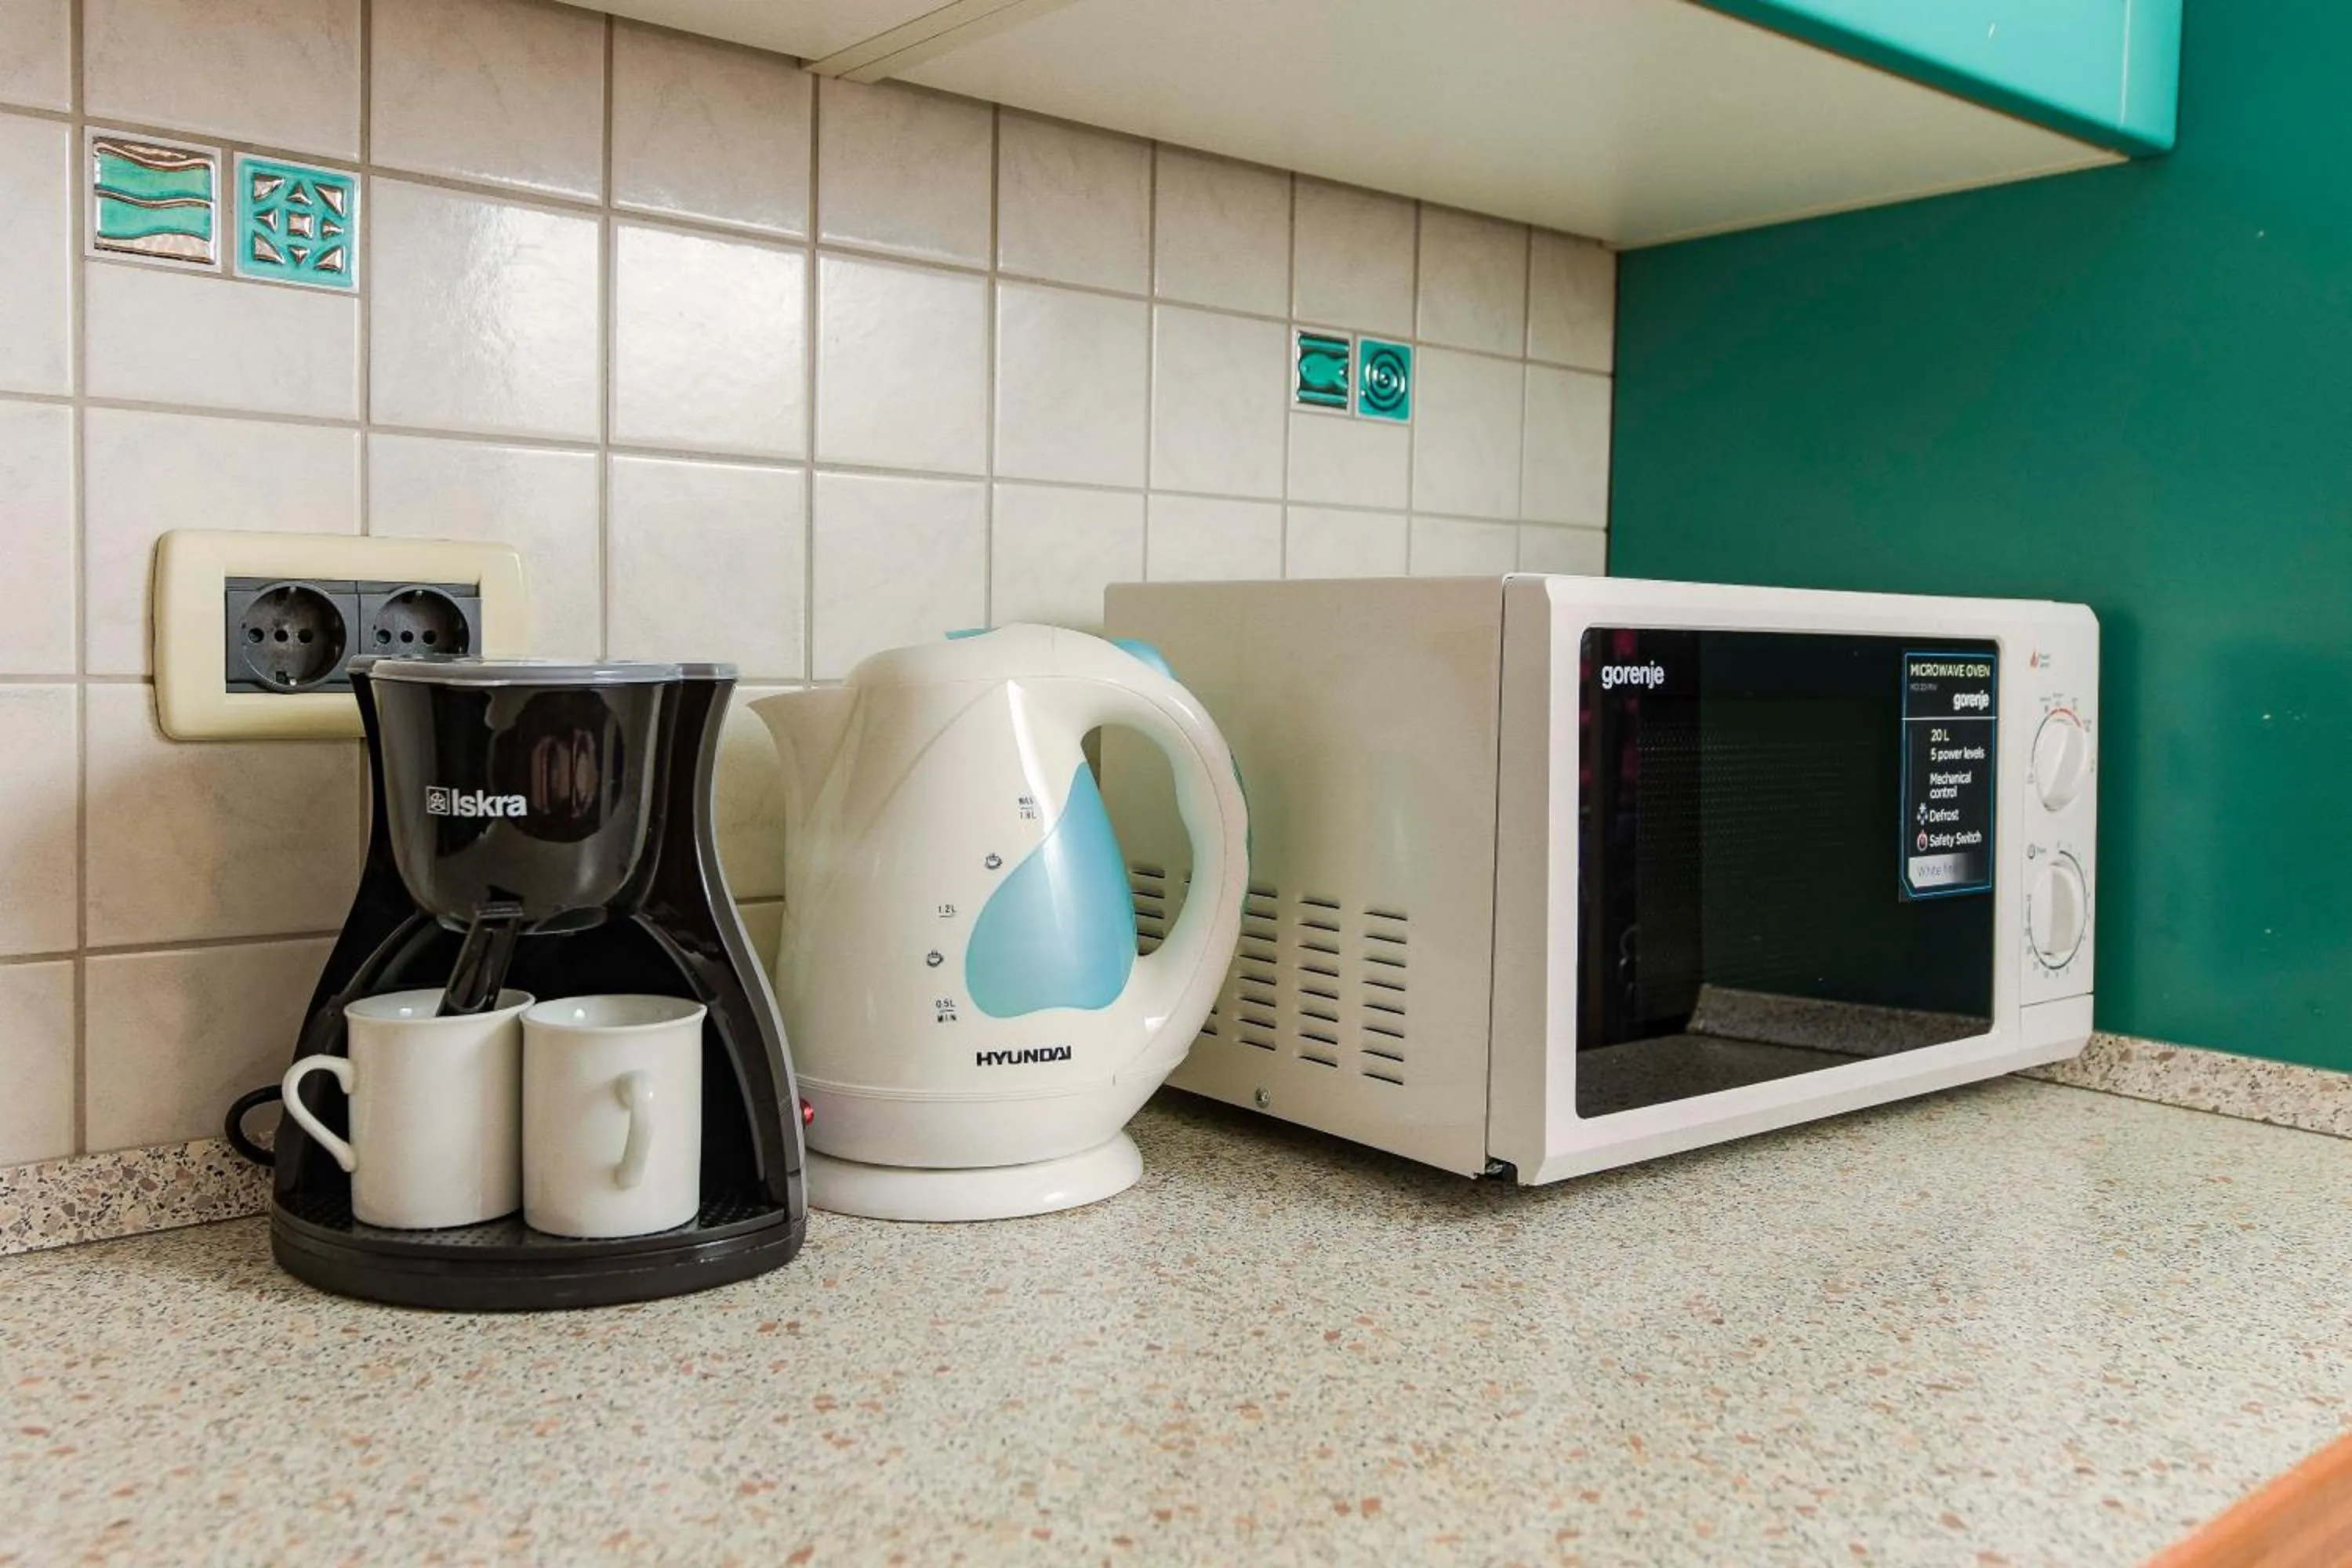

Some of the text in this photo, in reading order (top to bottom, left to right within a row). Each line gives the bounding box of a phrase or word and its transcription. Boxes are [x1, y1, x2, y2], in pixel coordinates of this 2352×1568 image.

[1602, 660, 1664, 689] gorenje
[1911, 663, 1991, 677] MICROWAVE OVEN
[1953, 690, 1990, 710] gorenje
[1931, 728, 1950, 742] 20 L
[1931, 746, 1985, 762] 5 power levels
[1929, 770, 1972, 785] Mechanical
[1929, 786, 1958, 799] control
[452, 788, 528, 817] Iskra
[1929, 808, 1959, 822] Defrost
[1929, 830, 1982, 848] Safety Switch
[976, 1045, 1072, 1067] HYUNDAI
